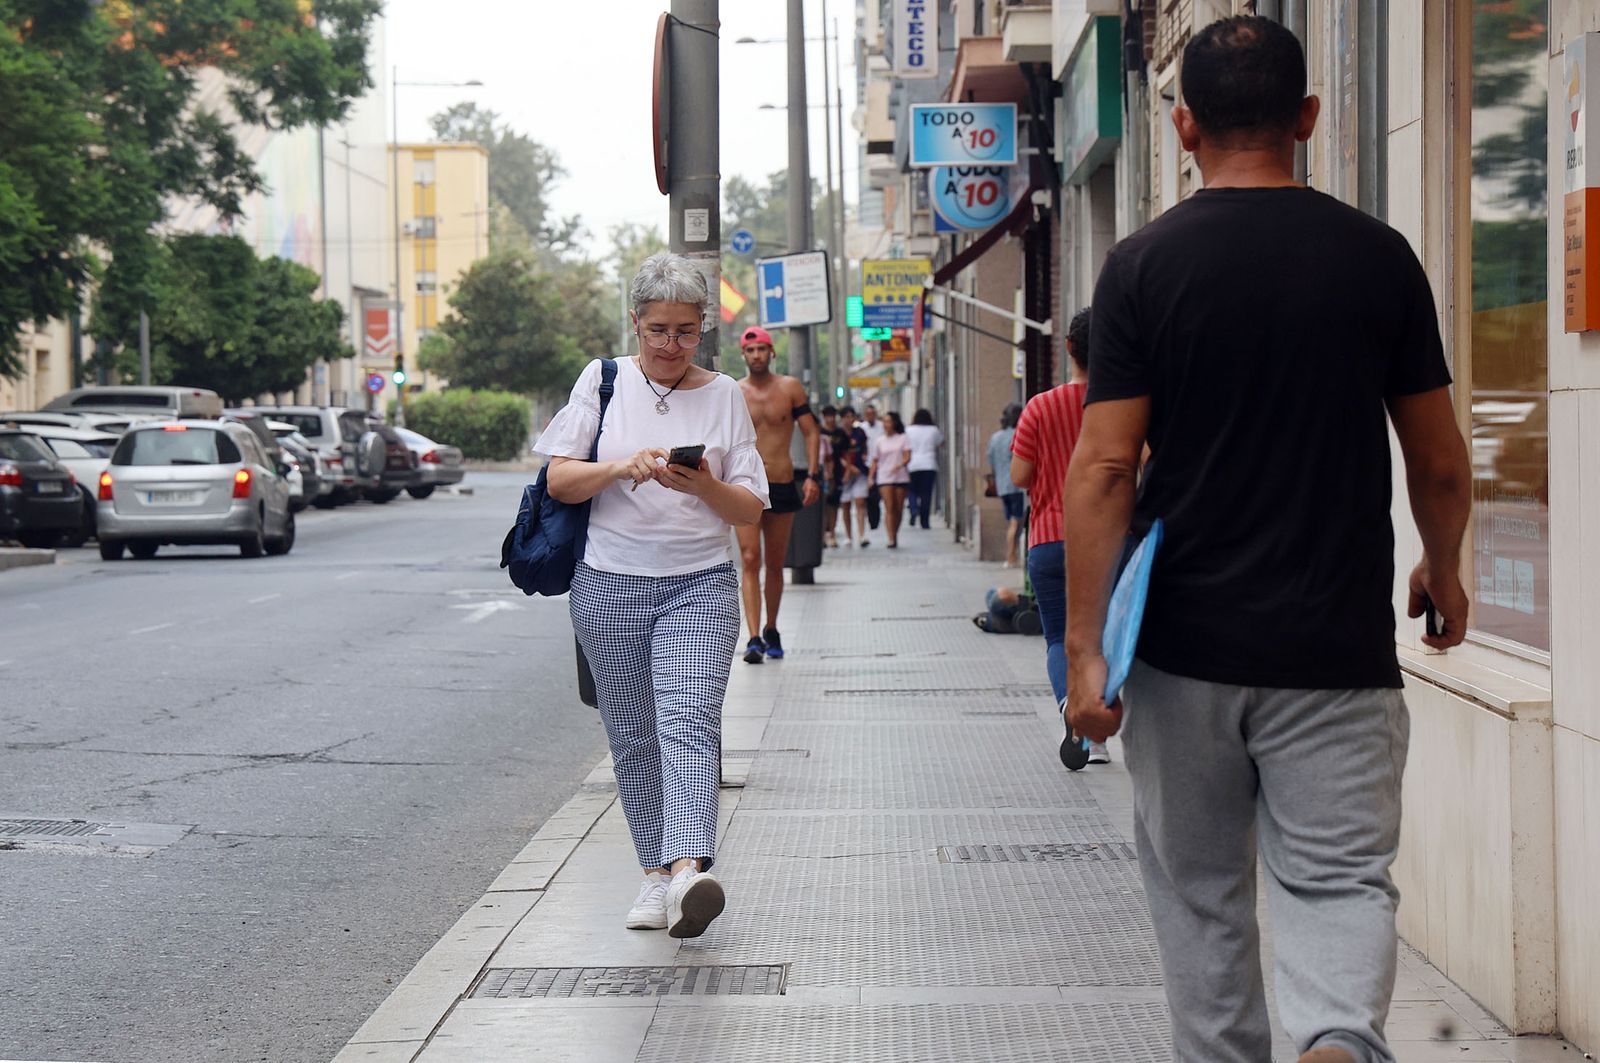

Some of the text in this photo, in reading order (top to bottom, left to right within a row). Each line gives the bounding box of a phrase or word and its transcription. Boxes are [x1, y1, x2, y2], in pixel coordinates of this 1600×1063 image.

[907, 0, 925, 67] TECO
[921, 111, 975, 126] TODO
[952, 128, 996, 149] A 10
[944, 180, 999, 208] A 10
